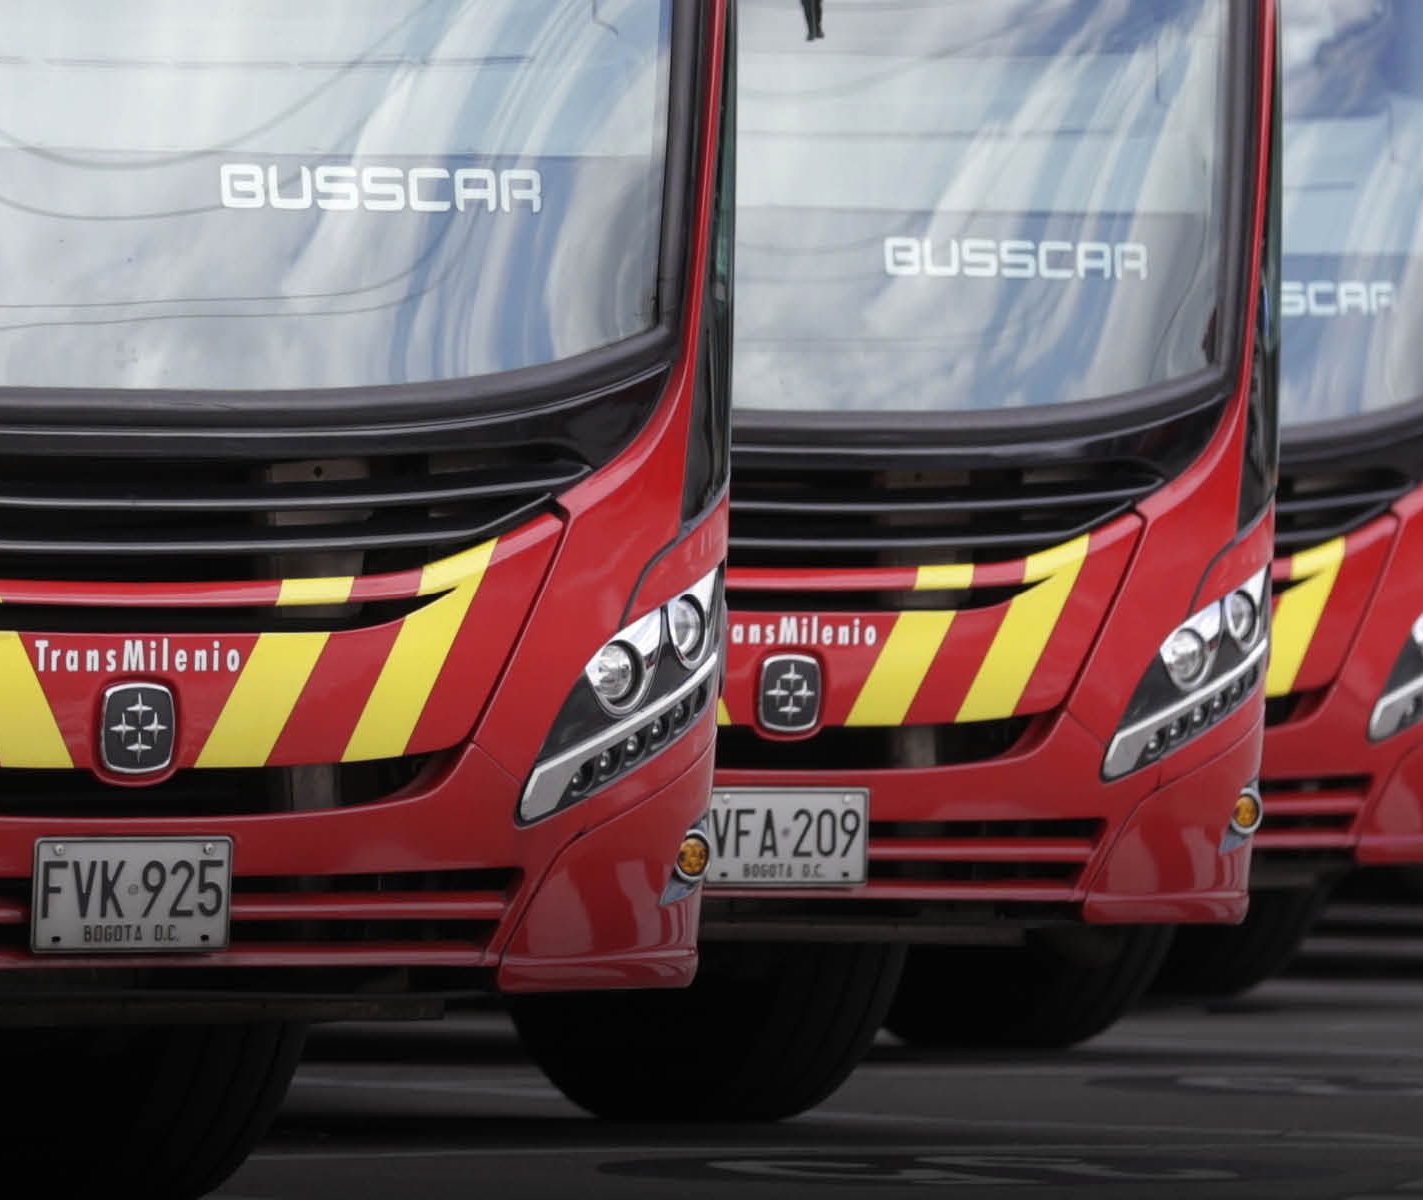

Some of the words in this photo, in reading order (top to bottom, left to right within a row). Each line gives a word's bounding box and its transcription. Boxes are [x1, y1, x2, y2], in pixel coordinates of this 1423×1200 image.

[220, 164, 542, 213] BUSSCAR
[884, 237, 1149, 279] BUSSCAR
[727, 616, 877, 645] ansMilenio
[35, 638, 240, 672] TransMilenio
[743, 864, 793, 878] BOGOTA
[84, 924, 142, 942] BOGOTA
